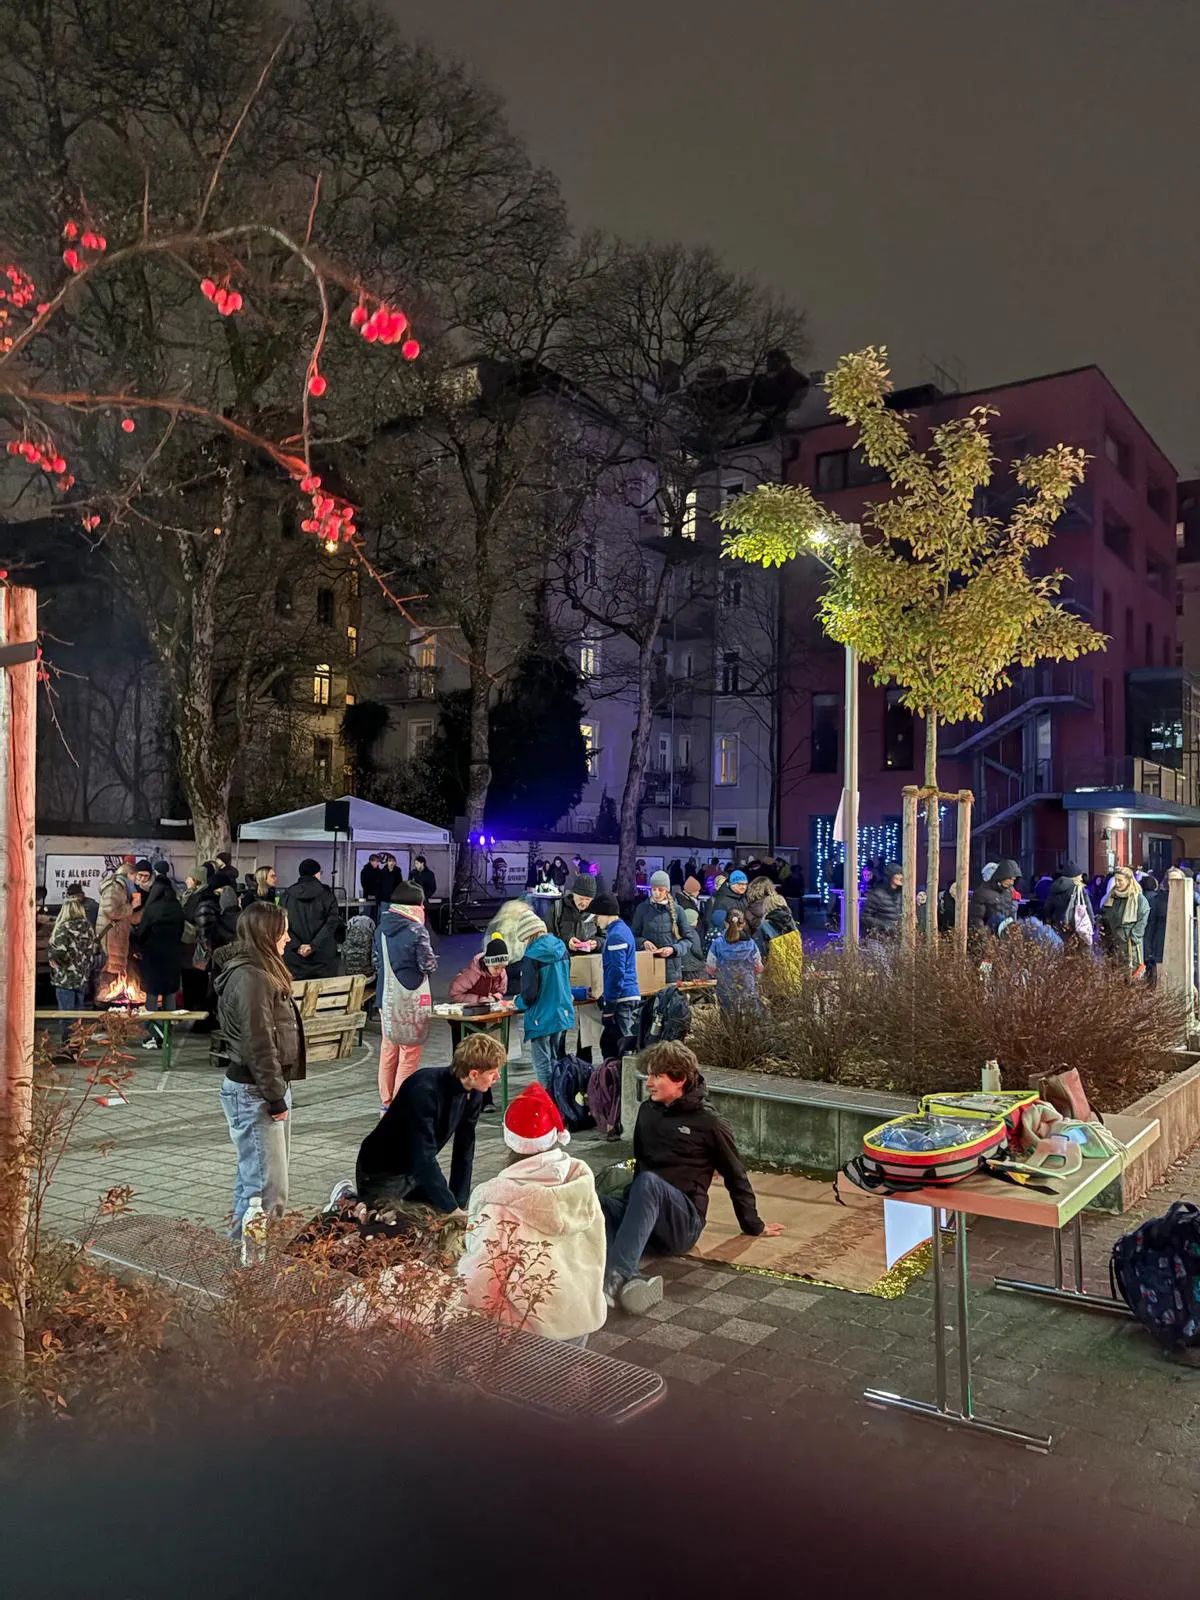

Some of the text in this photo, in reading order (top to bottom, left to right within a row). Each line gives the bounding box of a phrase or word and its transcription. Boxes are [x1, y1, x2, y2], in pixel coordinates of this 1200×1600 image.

[55, 869, 101, 878] WE ALL BLEED
[56, 880, 69, 888] THE
